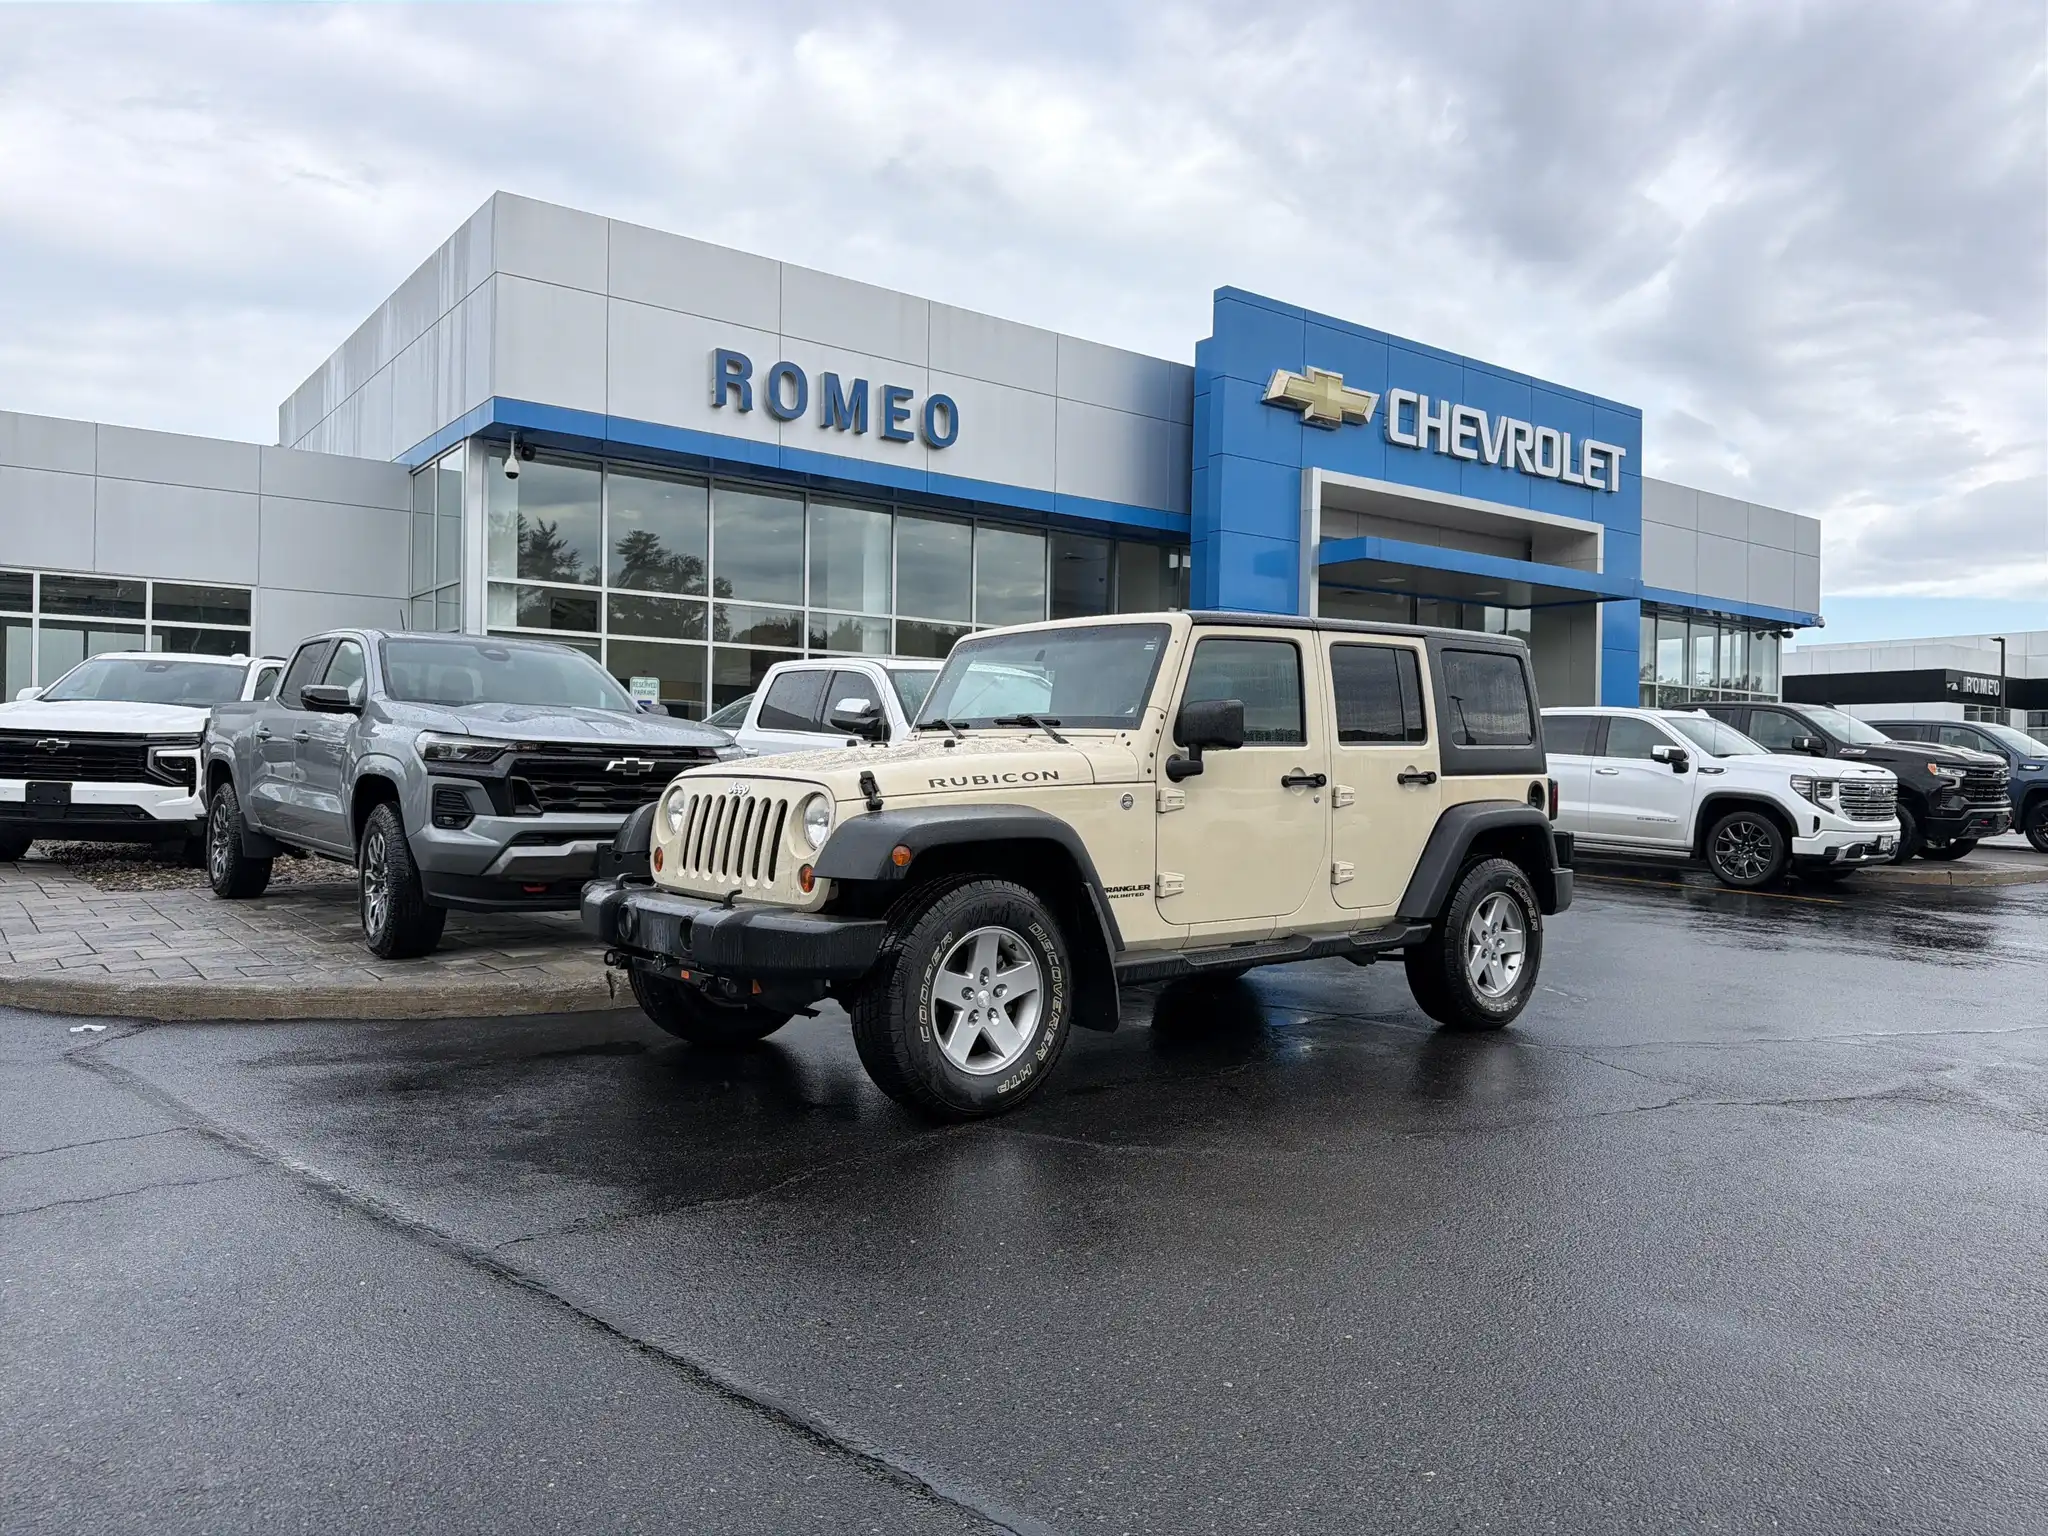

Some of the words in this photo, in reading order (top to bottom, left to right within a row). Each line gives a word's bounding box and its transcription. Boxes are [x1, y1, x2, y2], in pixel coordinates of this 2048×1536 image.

[711, 348, 959, 449] ROMEO
[1385, 387, 1627, 493] CHEVROLET
[632, 681, 657, 689] RESERVED
[633, 689, 656, 697] PARKING
[1963, 676, 2000, 696] ROMEO
[728, 781, 750, 797] Jeep
[928, 770, 1060, 788] RUBICON
[1506, 878, 1539, 931] COOPER
[918, 931, 953, 1043] COOPER
[1028, 922, 1063, 1061] DISCOVERER
[997, 1063, 1033, 1093] HTP
